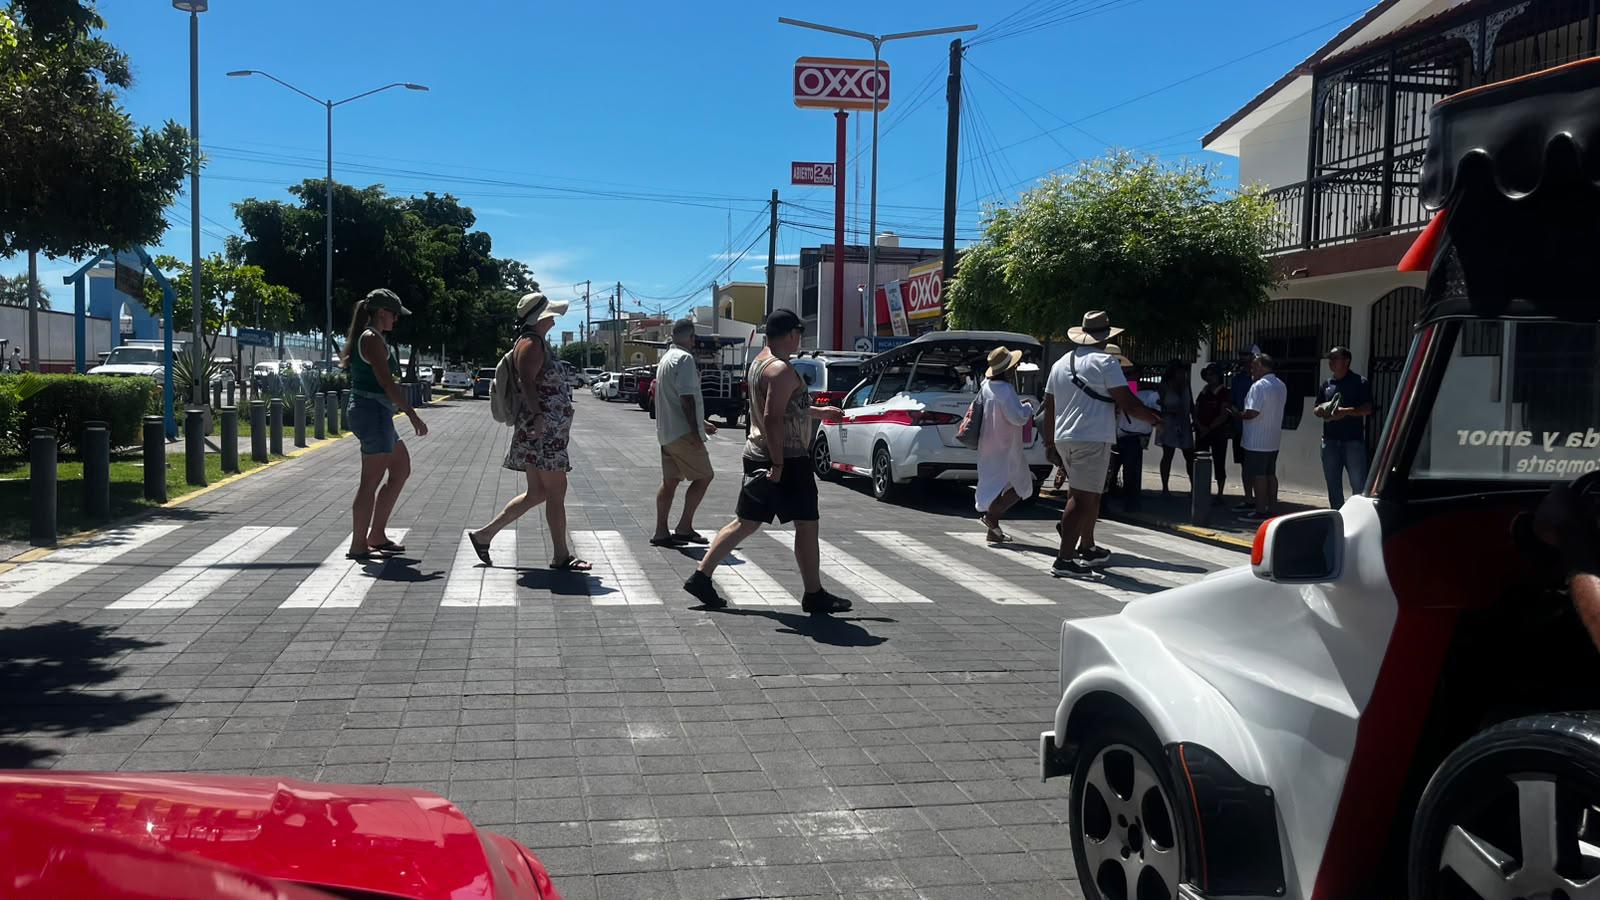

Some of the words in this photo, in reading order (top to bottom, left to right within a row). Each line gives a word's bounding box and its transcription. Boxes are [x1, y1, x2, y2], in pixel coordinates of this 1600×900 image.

[799, 68, 886, 97] OXXO
[815, 166, 832, 177] 24
[909, 273, 942, 310] OXXO
